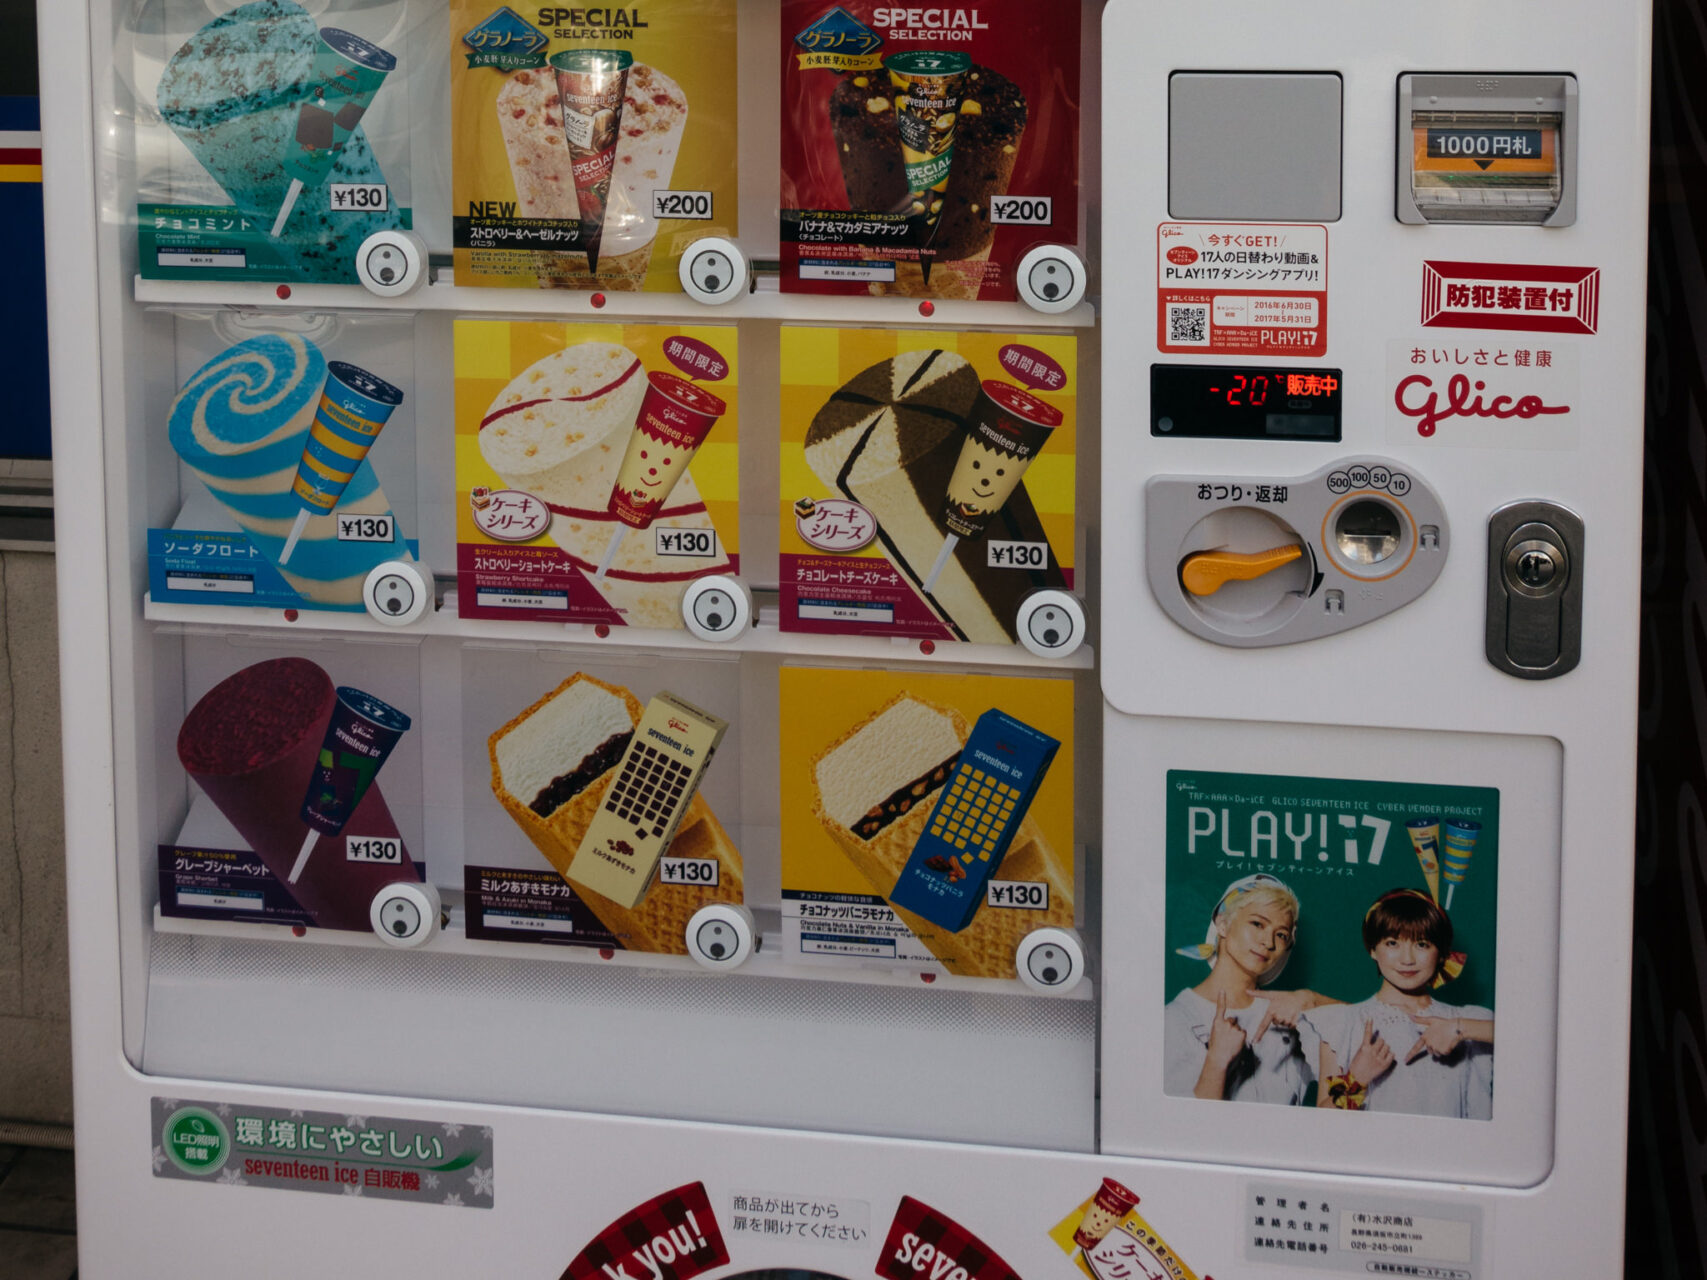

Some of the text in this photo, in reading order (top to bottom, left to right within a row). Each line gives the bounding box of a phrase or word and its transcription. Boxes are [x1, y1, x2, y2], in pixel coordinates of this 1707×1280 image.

[538, 8, 648, 28] SPECIAL
[873, 8, 988, 30] SPECIAL
[474, 27, 538, 48] グラノーラ
[554, 29, 633, 40] SELECTION
[807, 29, 873, 48] グラノーラ
[889, 30, 973, 41] SELECTION
[474, 53, 540, 65] 小麦胚芽入りコーン
[806, 55, 875, 67] 小麦胚芽入りコーン
[1437, 136, 1532, 156] 1000円札
[572, 151, 615, 176] SPECIAL
[906, 156, 952, 180] SPECIAL
[334, 188, 382, 208] ¥130
[657, 195, 708, 214] ¥200
[469, 201, 516, 217] NEW
[995, 201, 1048, 220] ¥200
[155, 217, 251, 230] チョコミント
[799, 221, 909, 236] バナナ&マカダミアナッツ
[470, 227, 579, 241] ストロベリー&ヘーゼルナッツ
[1208, 234, 1277, 247] 今すぐGET!
[1201, 251, 1319, 264] 17人の日替わり動画&
[1254, 302, 1311, 310] 2016年6月30日
[1446, 284, 1573, 312] 防犯装置付
[1254, 315, 1311, 323] 2017年5月31日
[667, 340, 724, 378] 期間限定
[1410, 348, 1552, 368] おいしさと健康
[1004, 349, 1062, 387] 期間限定
[1287, 373, 1337, 397] 販売中
[1395, 373, 1570, 437] Glico
[646, 413, 695, 443] seventeen ice
[979, 422, 1029, 455] seventeen ice
[1330, 477, 1349, 488] 500
[1350, 472, 1368, 484] 100
[1373, 473, 1386, 483] 50
[1394, 479, 1405, 490] 10
[1198, 484, 1288, 503] おつり・返却
[491, 497, 533, 513] ケーキ
[487, 514, 539, 529] シリーズ
[816, 507, 859, 522] ケーキ
[342, 520, 388, 538] ¥130
[811, 523, 865, 539] シリーズ
[164, 542, 259, 557] ソーダフロート
[660, 533, 709, 552] ¥130
[992, 545, 1043, 566] ¥130
[474, 558, 571, 573] ストロベリーショートケーキ
[797, 568, 898, 585] チョコレートチーズケーキ
[648, 727, 695, 756] seventeen ice
[974, 749, 1023, 779] seventeen ice
[1272, 797, 1298, 806] GLICO
[1300, 798, 1351, 809] SEVENTEEN
[1354, 801, 1368, 810] ICE
[1377, 803, 1405, 812] CYBER
[1444, 806, 1483, 816] PROJECT
[350, 842, 396, 859] ¥130
[175, 858, 270, 875] グレープシャーベット
[664, 863, 712, 881] ¥130
[481, 879, 570, 897] ミルクあずきモナカ
[992, 885, 1042, 904] ¥130
[800, 904, 894, 921] チョコナッツバニラモナカ
[235, 1117, 444, 1160] 環境にやさしい
[245, 1159, 421, 1191] seventeen ice 自販機
[733, 1196, 839, 1218] 商品が出てから
[1256, 1196, 1330, 1212] 管理者名
[733, 1215, 867, 1240] 扉を開けてください
[1255, 1216, 1329, 1232] 連絡先住所
[630, 1210, 708, 1280] you!
[1254, 1237, 1328, 1254] 連絡先電話番号
